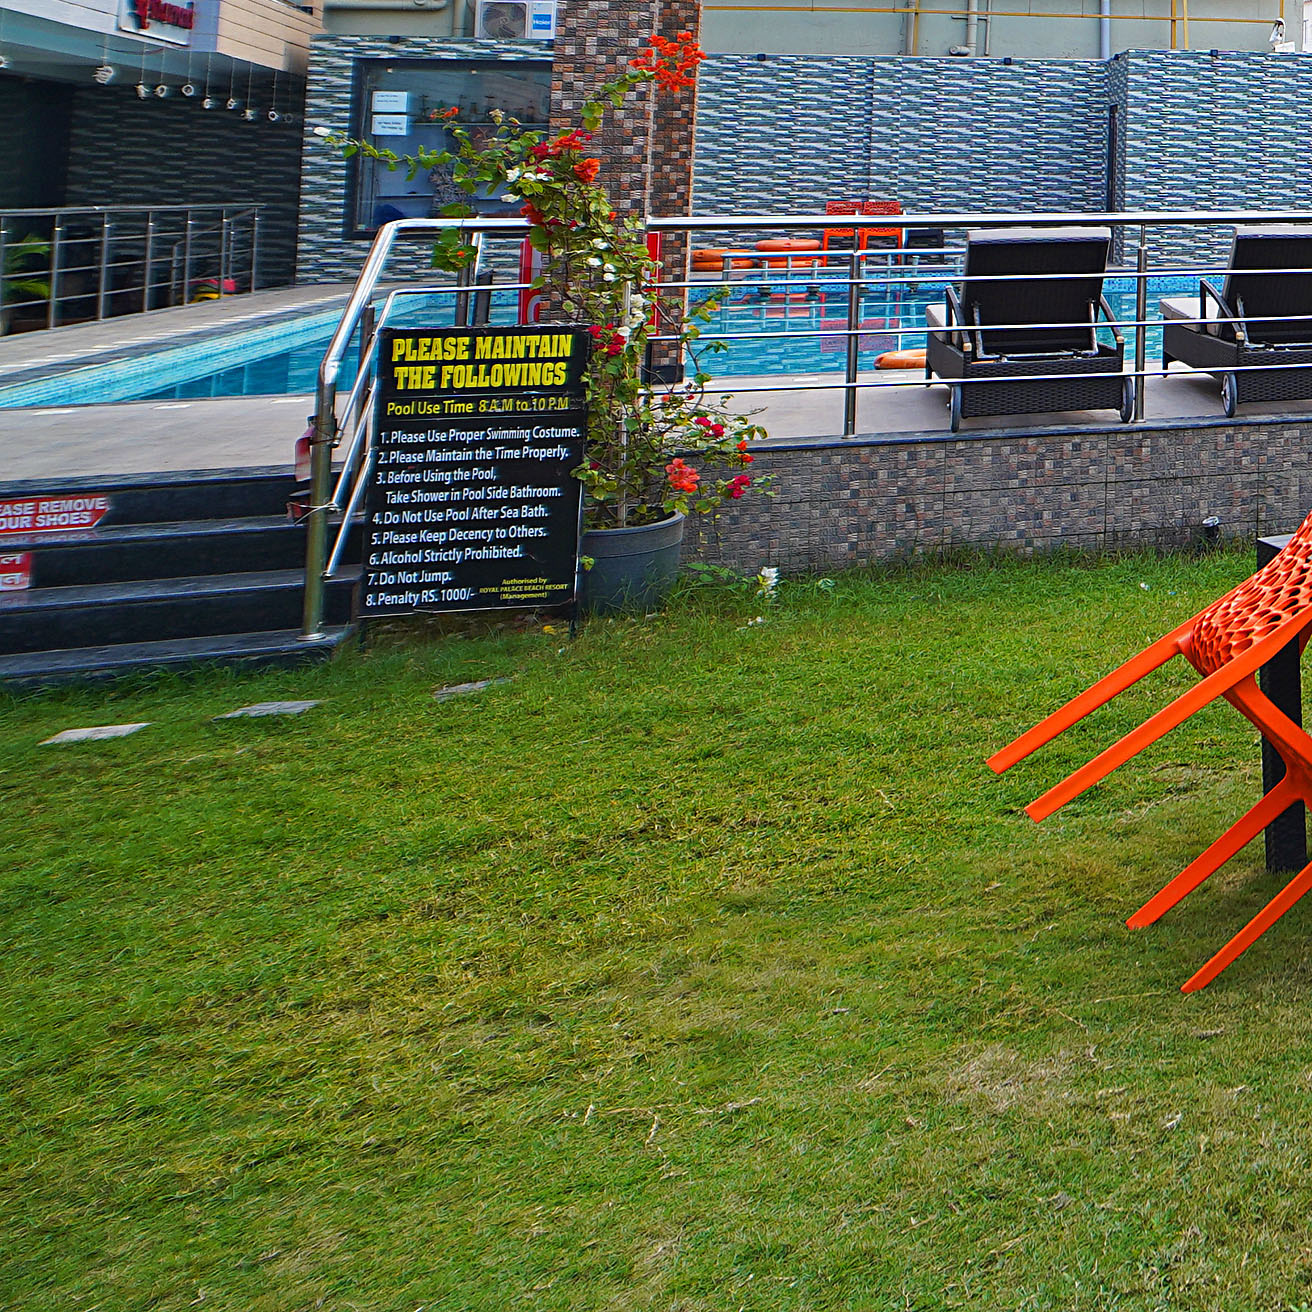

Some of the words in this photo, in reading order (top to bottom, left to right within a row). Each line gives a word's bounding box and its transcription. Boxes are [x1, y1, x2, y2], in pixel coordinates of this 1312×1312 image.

[392, 337, 470, 362] PLEASE
[475, 334, 573, 359] MAINTAIN
[394, 366, 436, 390] THE
[440, 362, 567, 389] FOLLOWINGS
[387, 401, 415, 416] Pool
[417, 402, 440, 414] Use
[443, 400, 473, 414] Time
[516, 399, 528, 411] to
[532, 397, 545, 410] 10
[427, 430, 447, 442] Use
[448, 429, 486, 444] Proper
[486, 427, 530, 442] Swimming
[532, 426, 580, 439] Costume.
[425, 448, 472, 462] Maintain
[475, 447, 493, 460] the
[494, 446, 521, 460] Time
[522, 444, 569, 461] Properly.
[423, 469, 451, 485] Using
[453, 468, 470, 481] the
[472, 466, 496, 481] Pool,
[385, 490, 410, 504] Take
[410, 489, 449, 503] Shower
[450, 488, 460, 501] in
[462, 487, 485, 501] Pool
[486, 486, 509, 499] Side
[510, 484, 561, 498] Bathroom.
[38, 497, 106, 514] REMOVE
[401, 511, 422, 523] Not
[424, 509, 444, 522] Use
[445, 507, 469, 521] Pool
[471, 506, 499, 520] After
[500, 505, 519, 519] Sea
[521, 504, 548, 518] Bath.
[35, 512, 92, 527] SHOES
[419, 530, 446, 545] Keep
[448, 528, 493, 542] Decency
[495, 527, 506, 539] to
[508, 525, 547, 538] Others.
[424, 548, 463, 564] Strictly
[464, 545, 523, 560] Prohibited.
[397, 572, 418, 584] Not
[419, 570, 452, 585] Jump.
[502, 577, 538, 585] Authorised
[538, 577, 547, 585] by
[421, 590, 438, 603] RS.
[500, 592, 548, 601] (Management)
